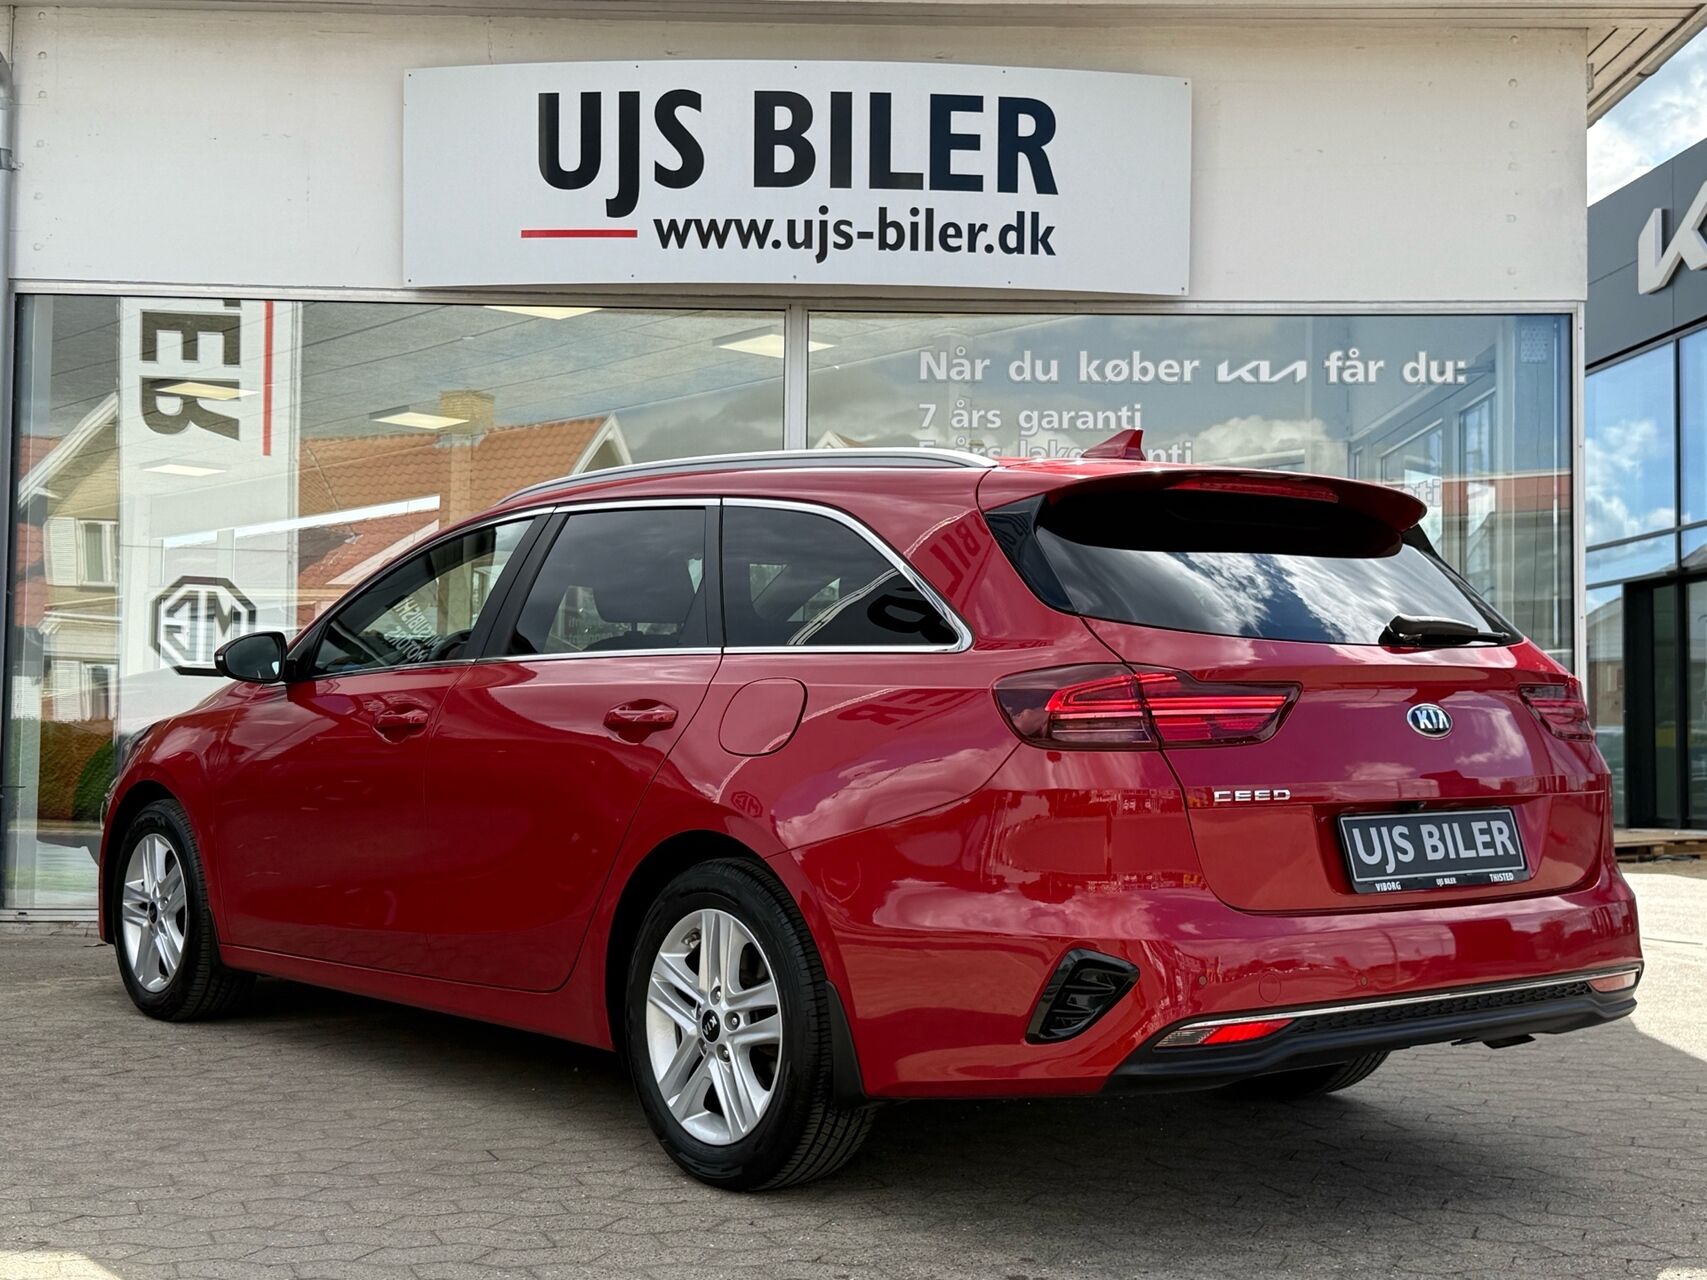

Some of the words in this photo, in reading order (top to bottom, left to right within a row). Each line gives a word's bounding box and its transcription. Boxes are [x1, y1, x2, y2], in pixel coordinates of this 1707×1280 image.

[538, 88, 705, 218] UJS
[753, 90, 1059, 196] BILER
[653, 205, 1056, 264] www.ujs-biler.dk
[919, 346, 991, 380] Når
[1008, 350, 1059, 381] du
[1079, 350, 1200, 382] køber
[1324, 348, 1385, 383] får
[1402, 351, 1467, 383] du:
[919, 403, 936, 428] 7
[951, 399, 1002, 428] års
[1018, 403, 1142, 436] garanti
[1412, 707, 1450, 730] KIA
[1213, 789, 1291, 802] CEED
[1352, 825, 1415, 874] UJS
[1420, 820, 1516, 861] BILER
[1375, 881, 1402, 892] VIBORG
[1489, 872, 1514, 882] THISTED
